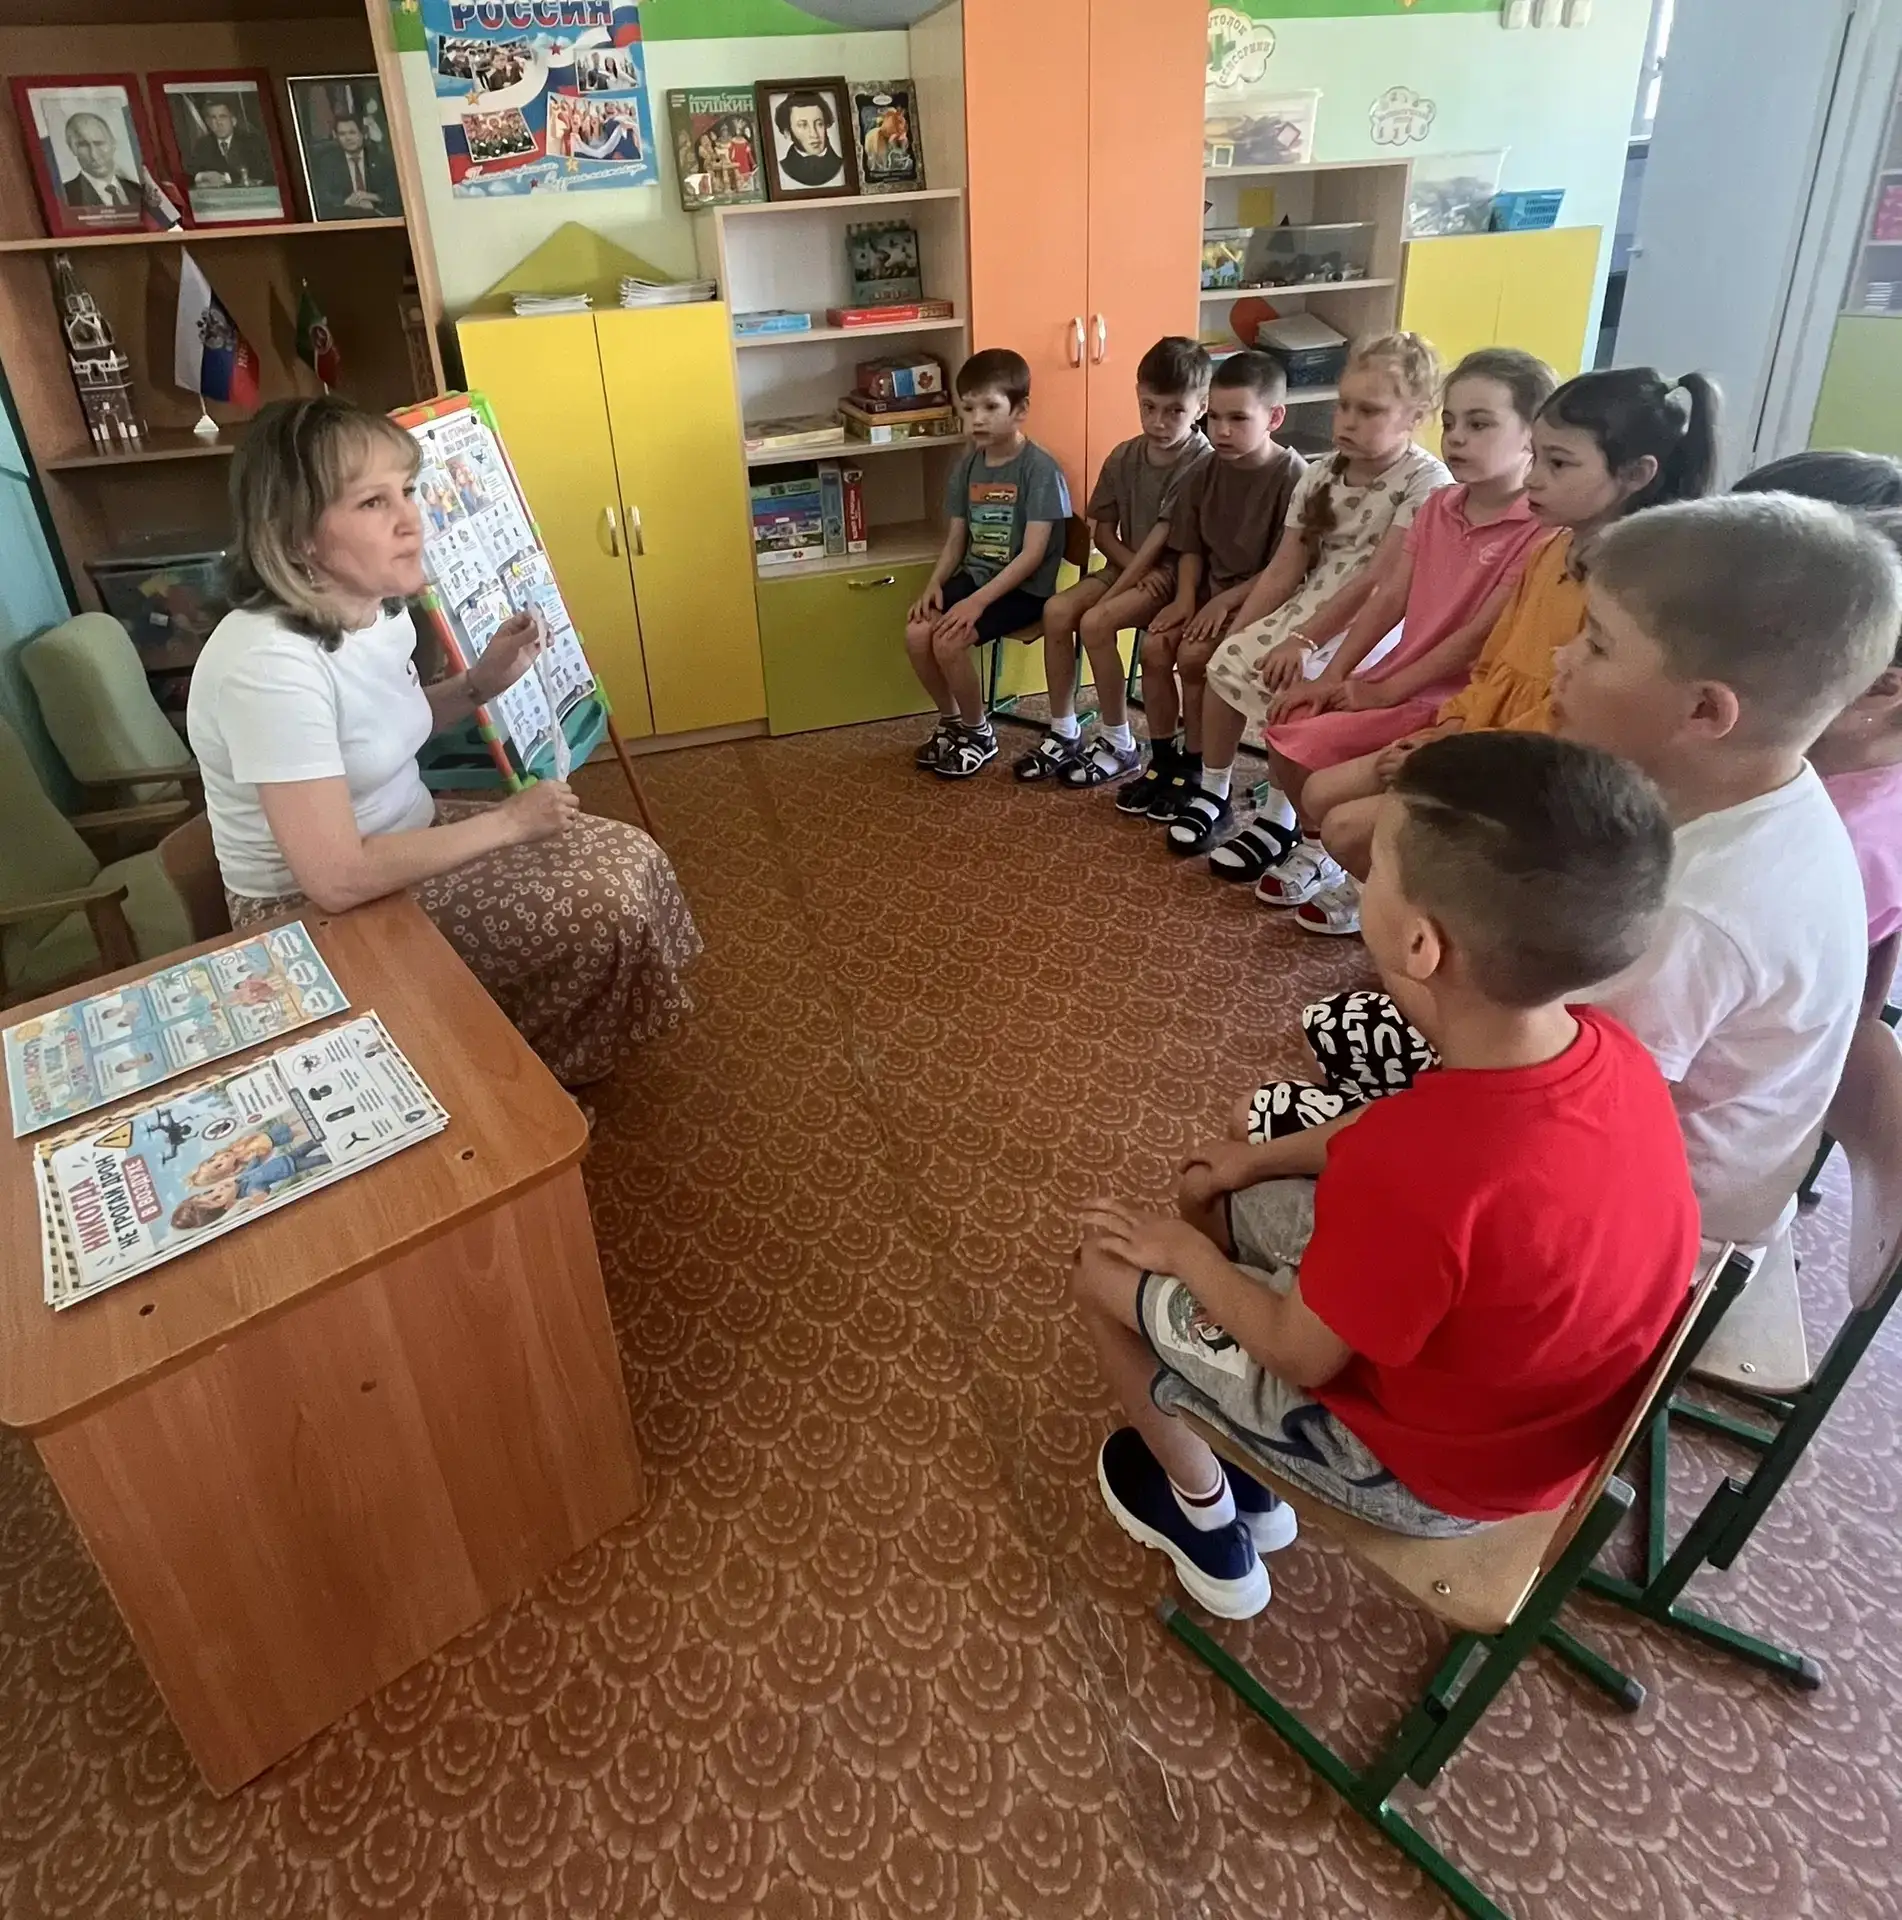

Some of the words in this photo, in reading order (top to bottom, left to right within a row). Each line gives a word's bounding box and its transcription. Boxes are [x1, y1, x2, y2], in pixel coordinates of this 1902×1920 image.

[450, 0, 613, 31] РОССИЯ
[689, 99, 755, 114] ПУШКИН
[95, 1154, 124, 1188] ДРОН
[125, 1159, 156, 1208] ВОЗДУХЕ
[68, 1176, 111, 1254] НИКОГДА
[101, 1185, 135, 1233] ТРОГАЙ
[140, 1205, 160, 1219] В
[117, 1228, 140, 1250] НЕ
